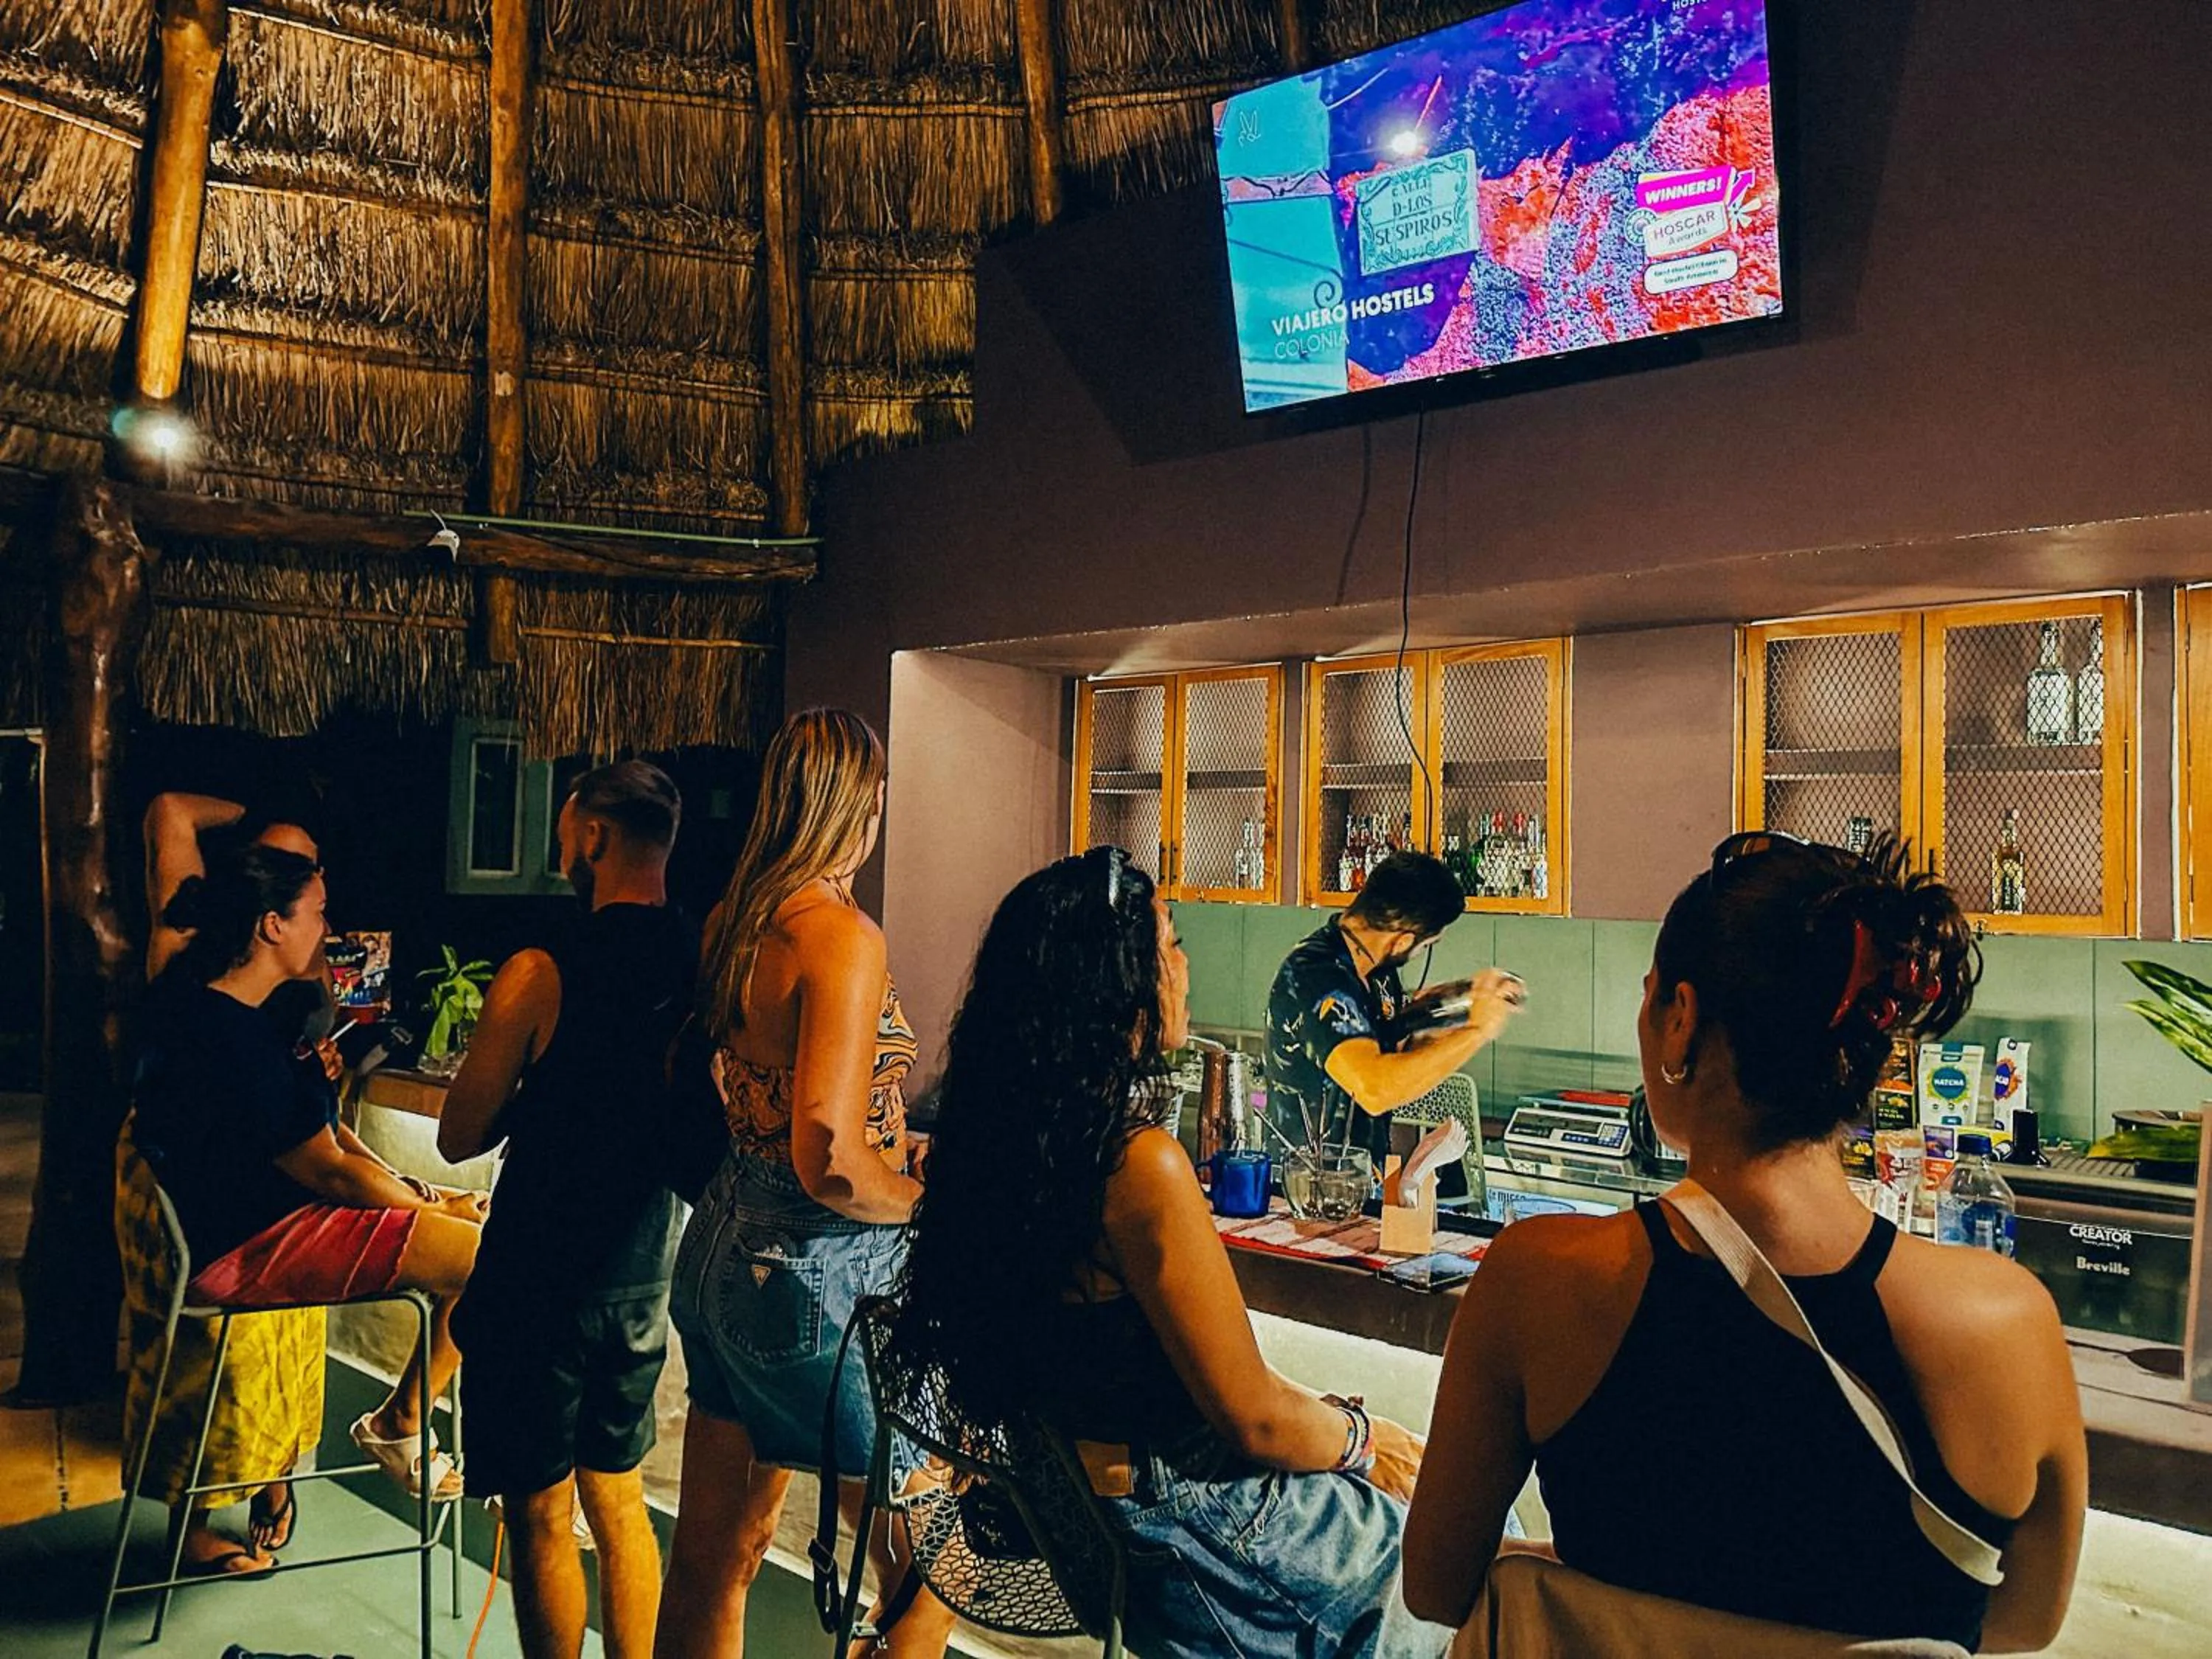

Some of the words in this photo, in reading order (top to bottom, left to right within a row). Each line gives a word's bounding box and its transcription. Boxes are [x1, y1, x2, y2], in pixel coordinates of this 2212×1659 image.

[1645, 177, 1722, 204] WINNERS!
[1654, 210, 1716, 240] HOSCAR
[1271, 302, 1348, 336] VIAJERO
[1351, 282, 1435, 321] HOSTELS
[1274, 330, 1350, 360] COLONIA
[1933, 1078, 1965, 1087] MATCHA
[2069, 1225, 2133, 1245] CREATOR
[2076, 1255, 2131, 1276] Breville
